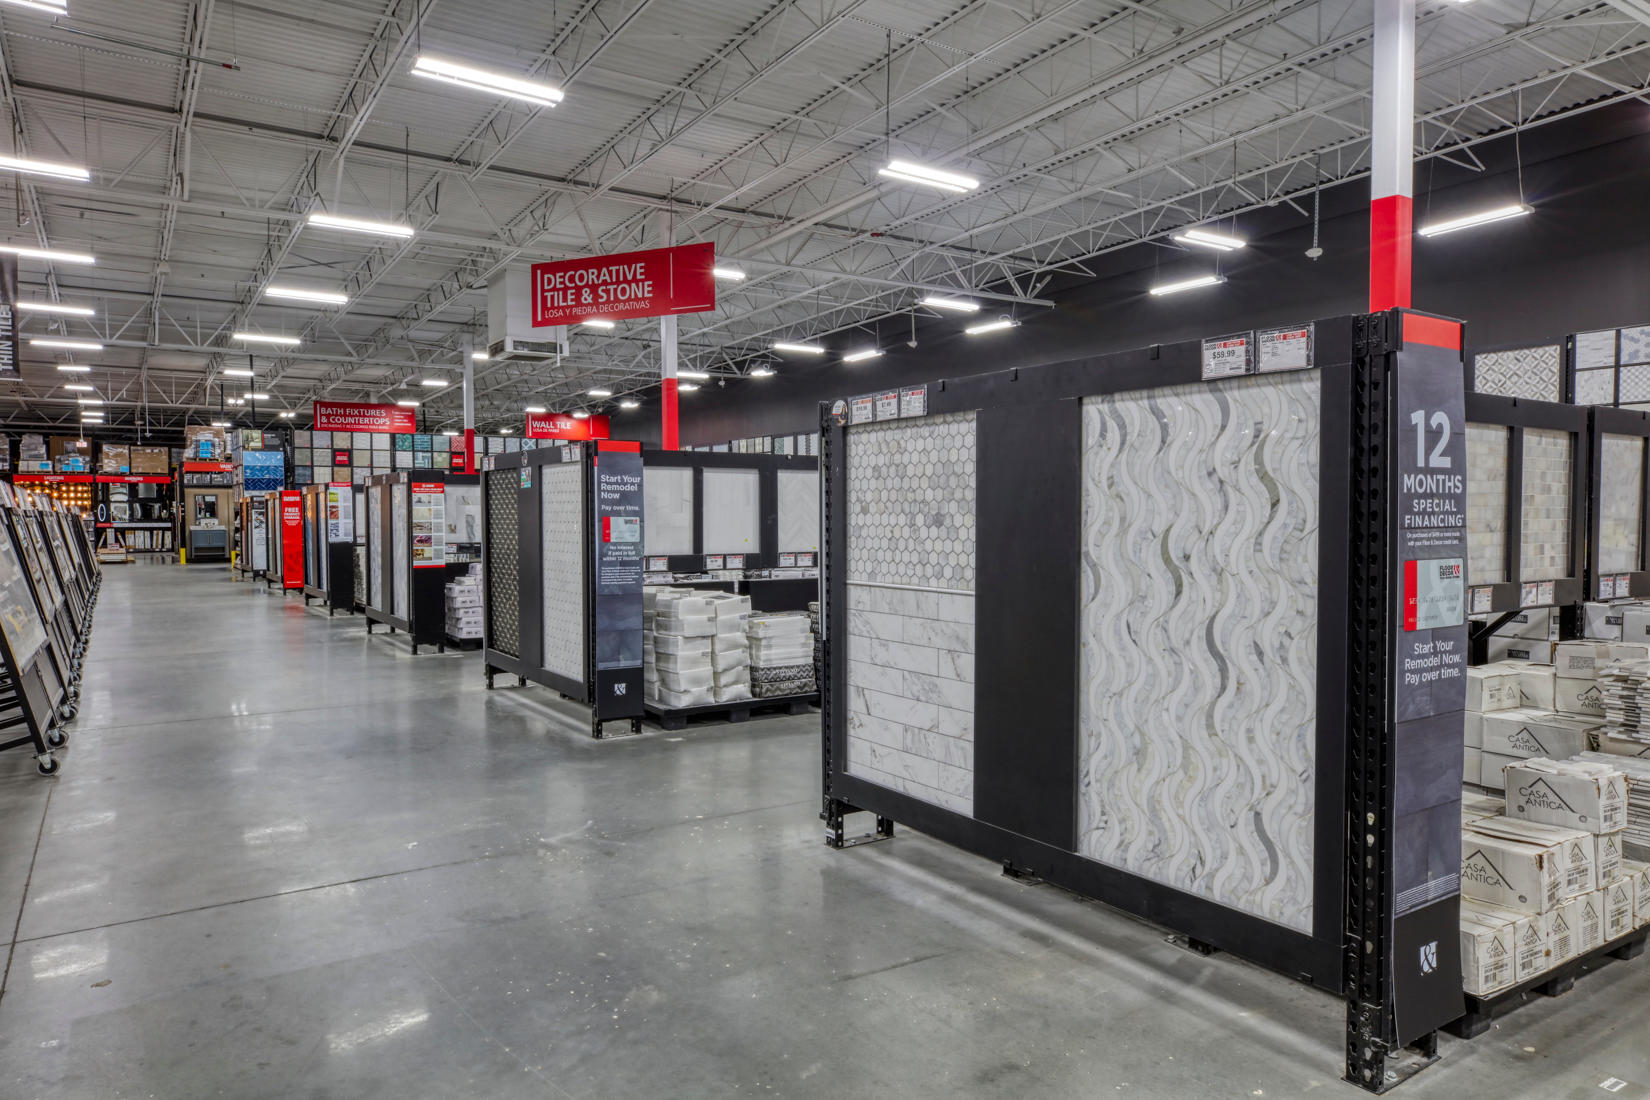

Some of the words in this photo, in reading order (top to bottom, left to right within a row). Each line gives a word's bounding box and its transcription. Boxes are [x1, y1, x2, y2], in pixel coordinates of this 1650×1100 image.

[544, 263, 646, 290] DECORATIVE
[544, 290, 576, 307] TILE
[581, 288, 593, 304] &
[598, 281, 653, 302] STONE
[545, 310, 564, 318] LOSA
[565, 308, 571, 316] Y
[572, 305, 597, 315] PIEDRA
[599, 300, 650, 313] DECORATIVAS
[1212, 349, 1236, 360] $59.99
[346, 408, 386, 417] FIXTURES
[330, 416, 391, 425] COUNTERTOPS
[532, 421, 555, 429] WALL
[556, 422, 572, 430] TILE
[1410, 410, 1451, 468] 12
[601, 474, 621, 482] Start
[622, 475, 641, 483] Your
[1403, 474, 1463, 494] MONTHS
[601, 483, 638, 491] Remodel
[1413, 499, 1457, 512] SPECIAL
[1414, 642, 1433, 655] Start
[1435, 640, 1454, 651] Your
[1405, 655, 1441, 670] Remodel
[1442, 653, 1462, 665] Now.
[1405, 673, 1420, 686] Pay
[1422, 671, 1439, 682] over
[1441, 666, 1461, 679] time.
[1576, 693, 1600, 703] CASA
[1508, 735, 1530, 745] CASA
[1512, 743, 1541, 753] ANTICA
[1518, 787, 1549, 800] CASA
[1525, 798, 1565, 811] ANTICA
[1462, 870, 1502, 888] ANTICA
